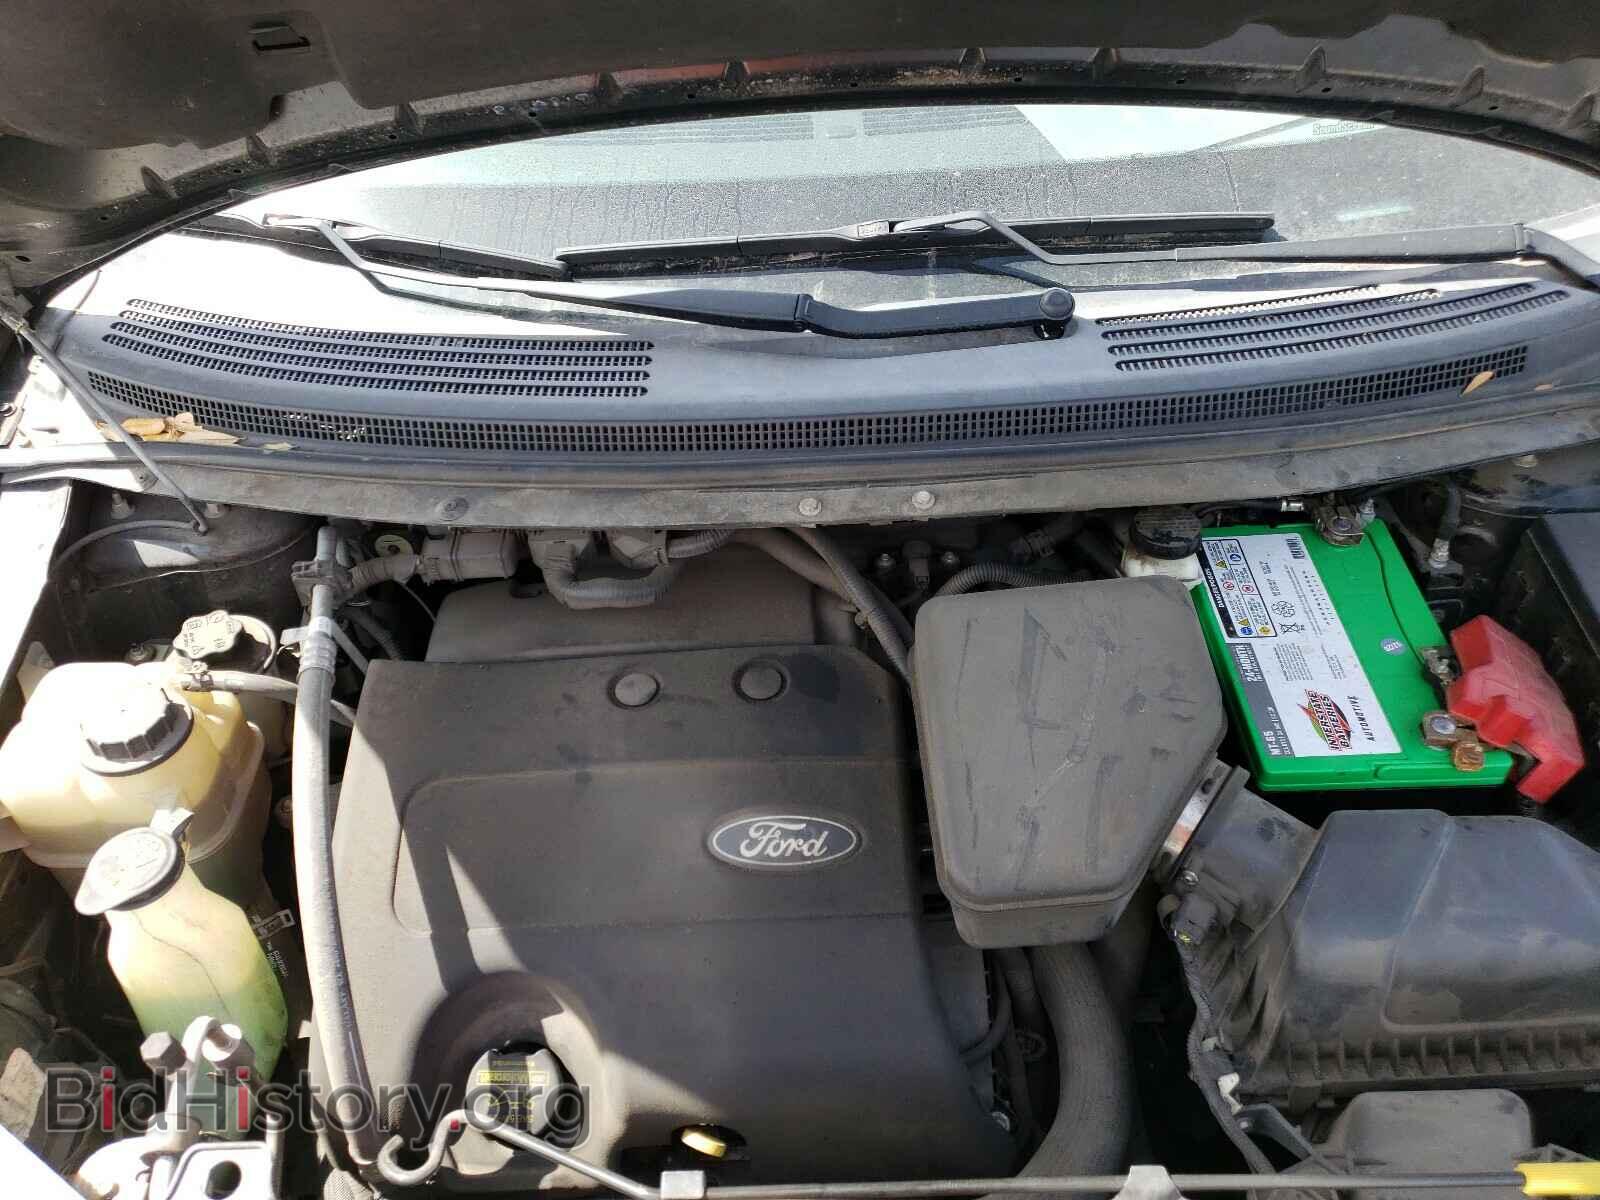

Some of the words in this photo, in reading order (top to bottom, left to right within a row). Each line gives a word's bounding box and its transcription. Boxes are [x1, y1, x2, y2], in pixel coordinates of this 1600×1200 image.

[1307, 690, 1339, 750] INTERSTATE
[1321, 694, 1351, 748] BATTERIES
[1346, 695, 1376, 742] AUTOMOTIVE
[740, 821, 828, 857] Ford
